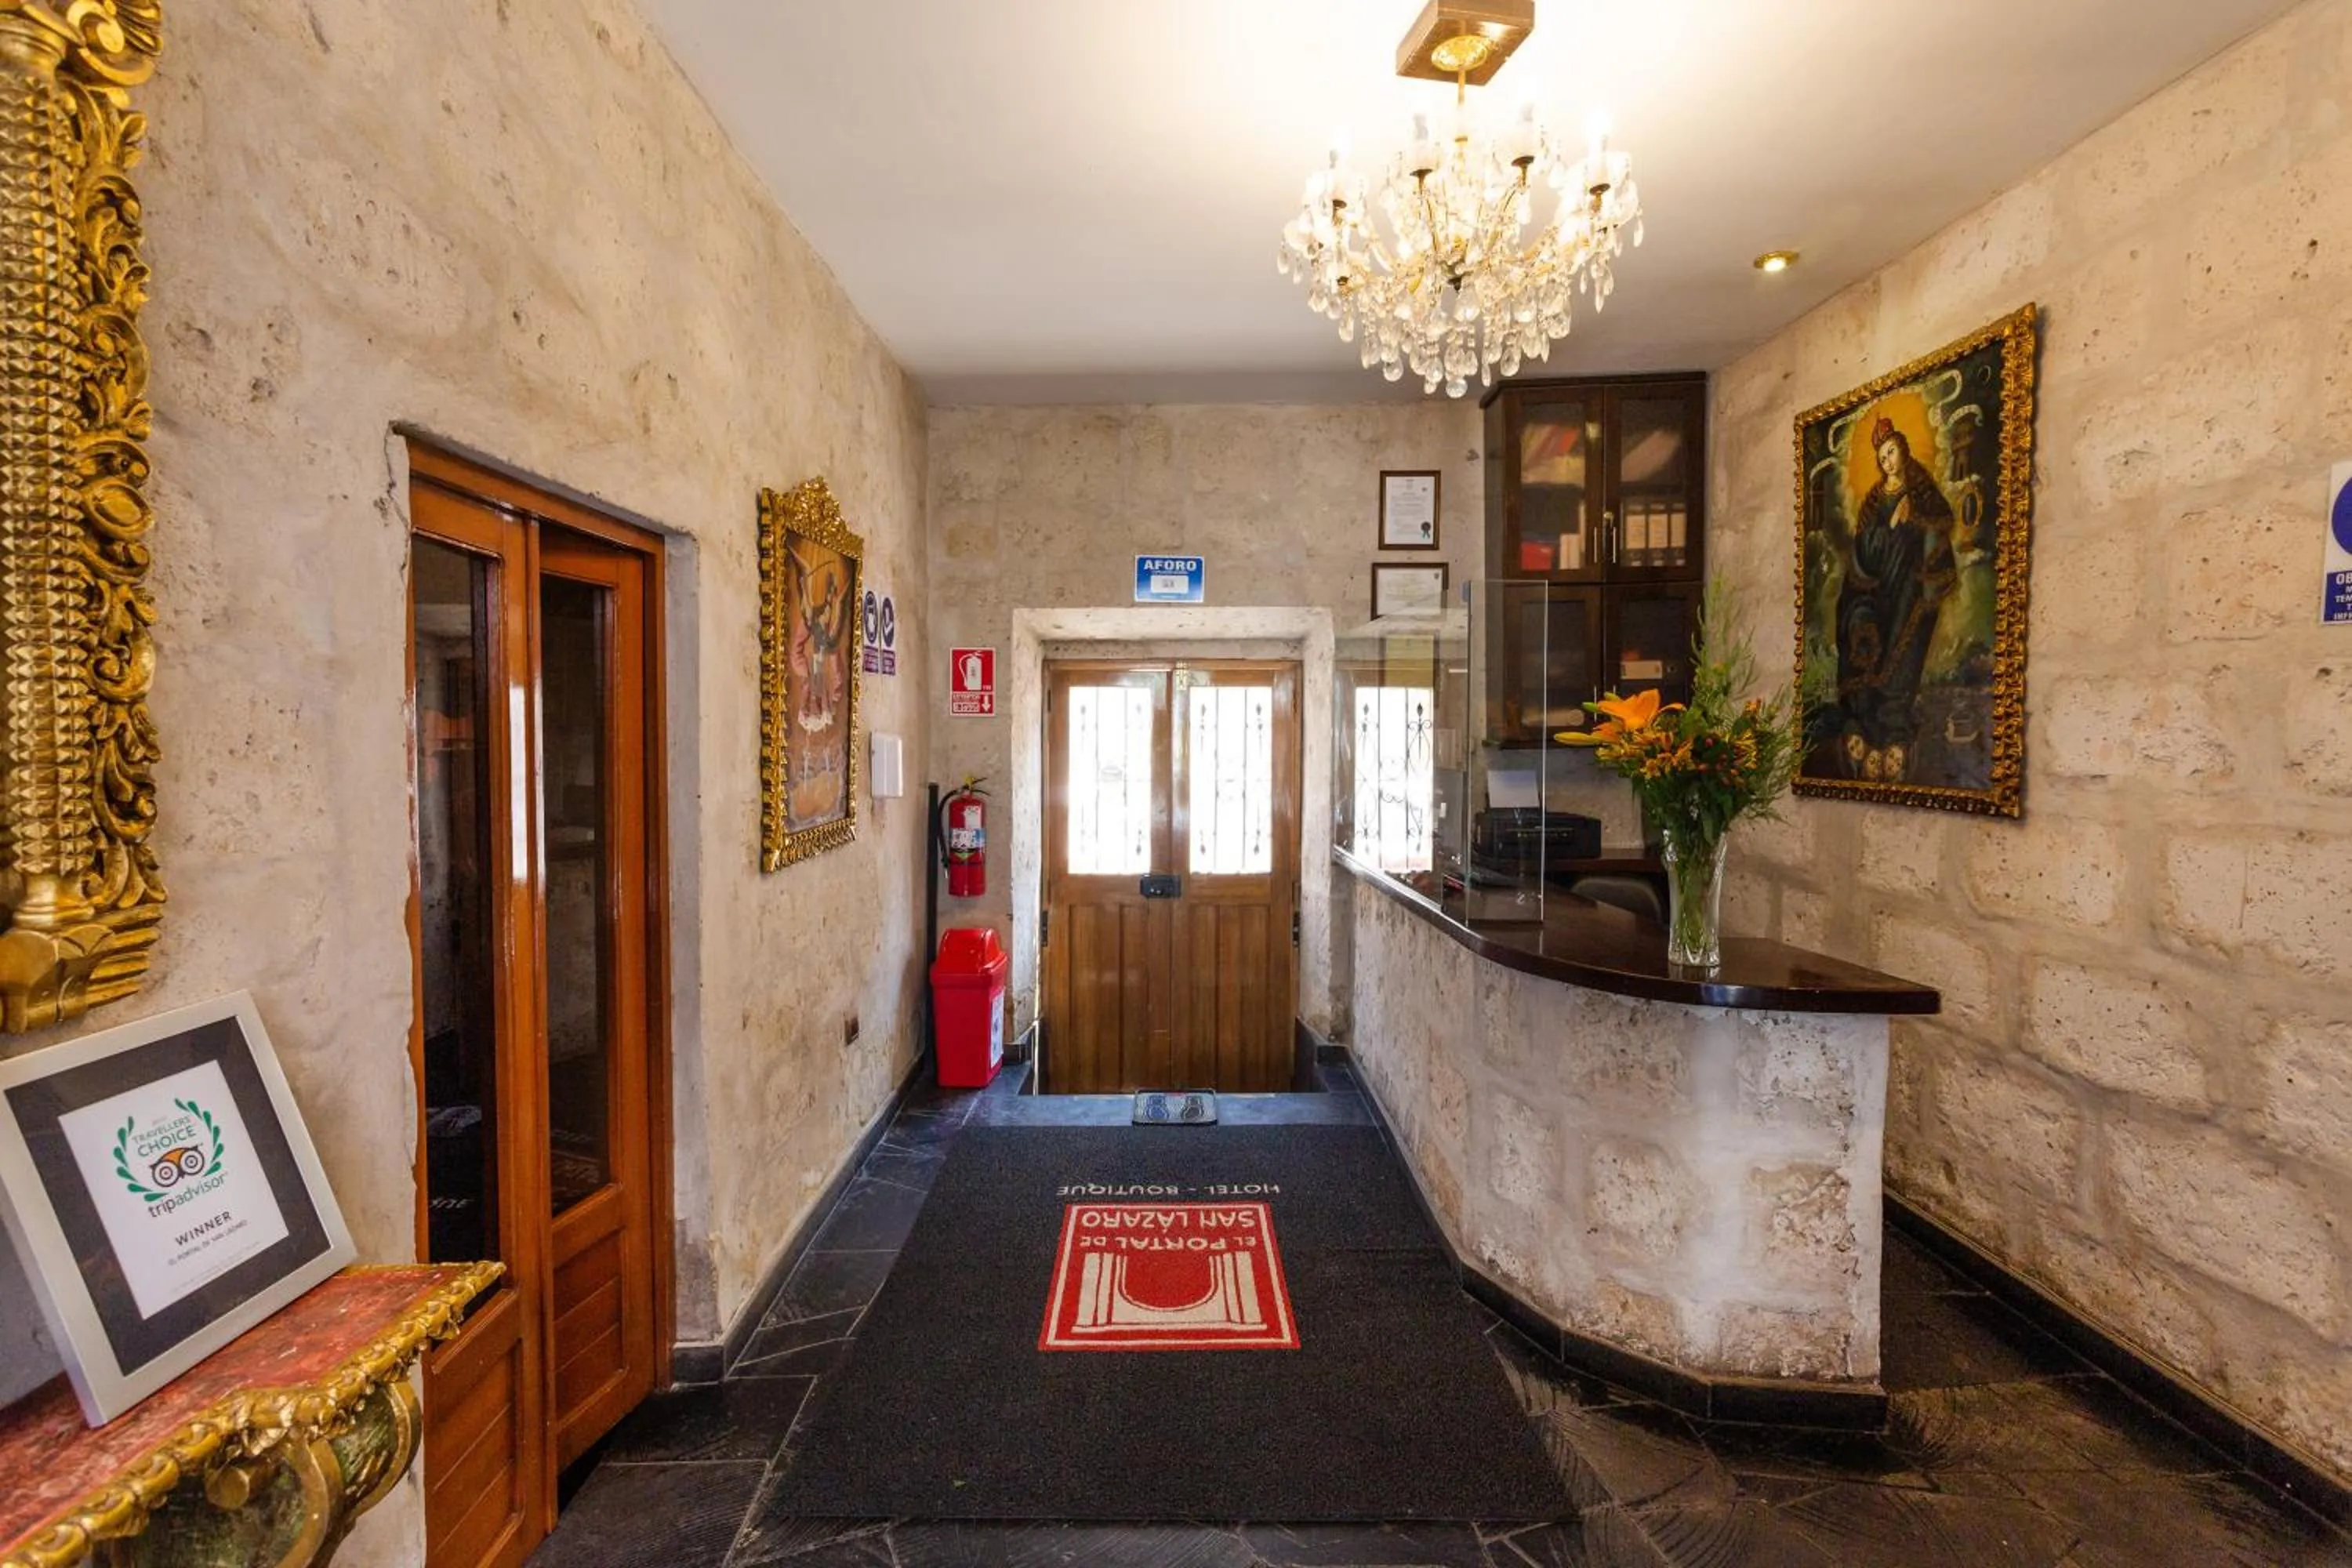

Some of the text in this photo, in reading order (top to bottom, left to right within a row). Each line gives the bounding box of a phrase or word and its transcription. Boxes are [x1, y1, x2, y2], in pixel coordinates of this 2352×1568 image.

[1144, 559, 1197, 572] AFORO
[137, 1125, 197, 1157] CHOICE
[148, 1174, 226, 1218] tripadvisor
[1055, 1182, 1178, 1196] BOUTIQUE
[1203, 1184, 1280, 1196] HOTEL
[175, 1211, 231, 1246] WINNER
[1081, 1210, 1255, 1234] SAN LÁZARO
[1080, 1236, 1256, 1250] EL PORTAL DE
